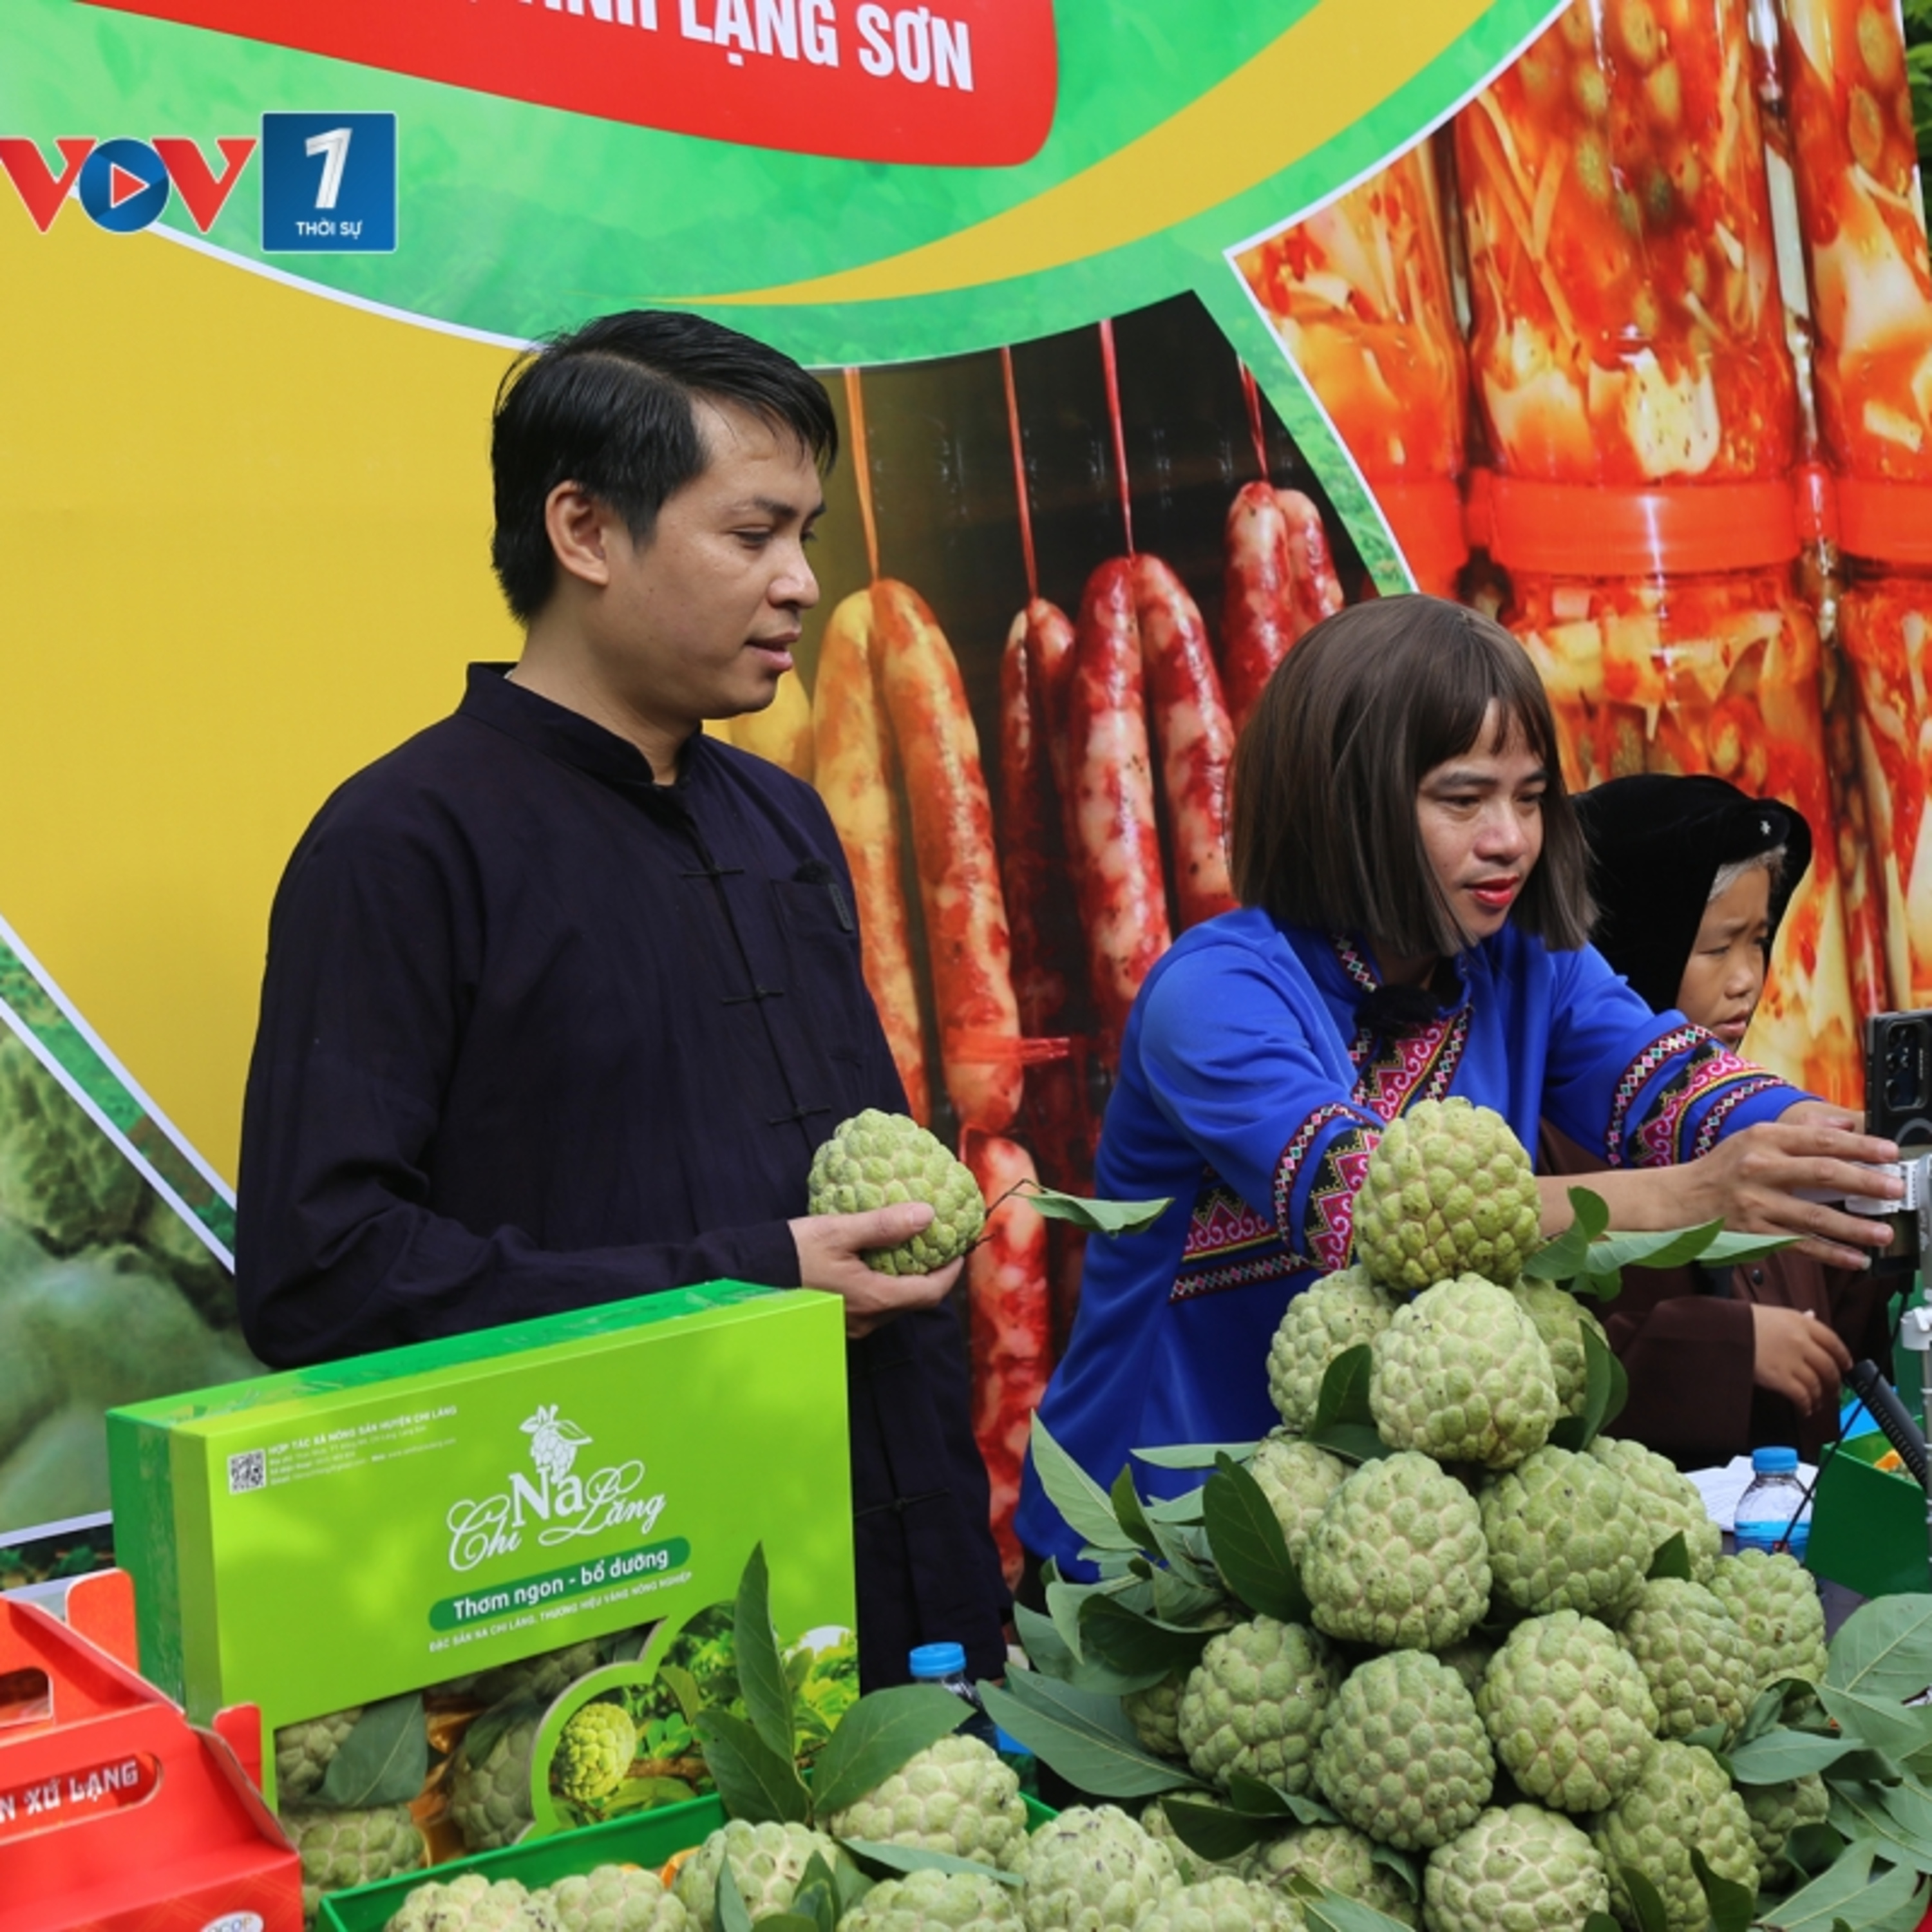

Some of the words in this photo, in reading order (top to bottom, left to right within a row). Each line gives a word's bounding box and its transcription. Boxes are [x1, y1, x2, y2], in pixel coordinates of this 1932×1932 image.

[679, 0, 839, 67] LẠNG
[856, 3, 974, 91] SƠN
[447, 1493, 522, 1571] Chi
[538, 1459, 666, 1546] Lăng
[508, 1465, 587, 1528] Na
[453, 1593, 510, 1620] Thơm
[513, 1578, 564, 1605] ngon
[581, 1560, 605, 1586] bổ
[609, 1549, 668, 1578] dưỡng
[489, 1622, 509, 1636] CHI
[69, 1760, 138, 1803] LẠNG
